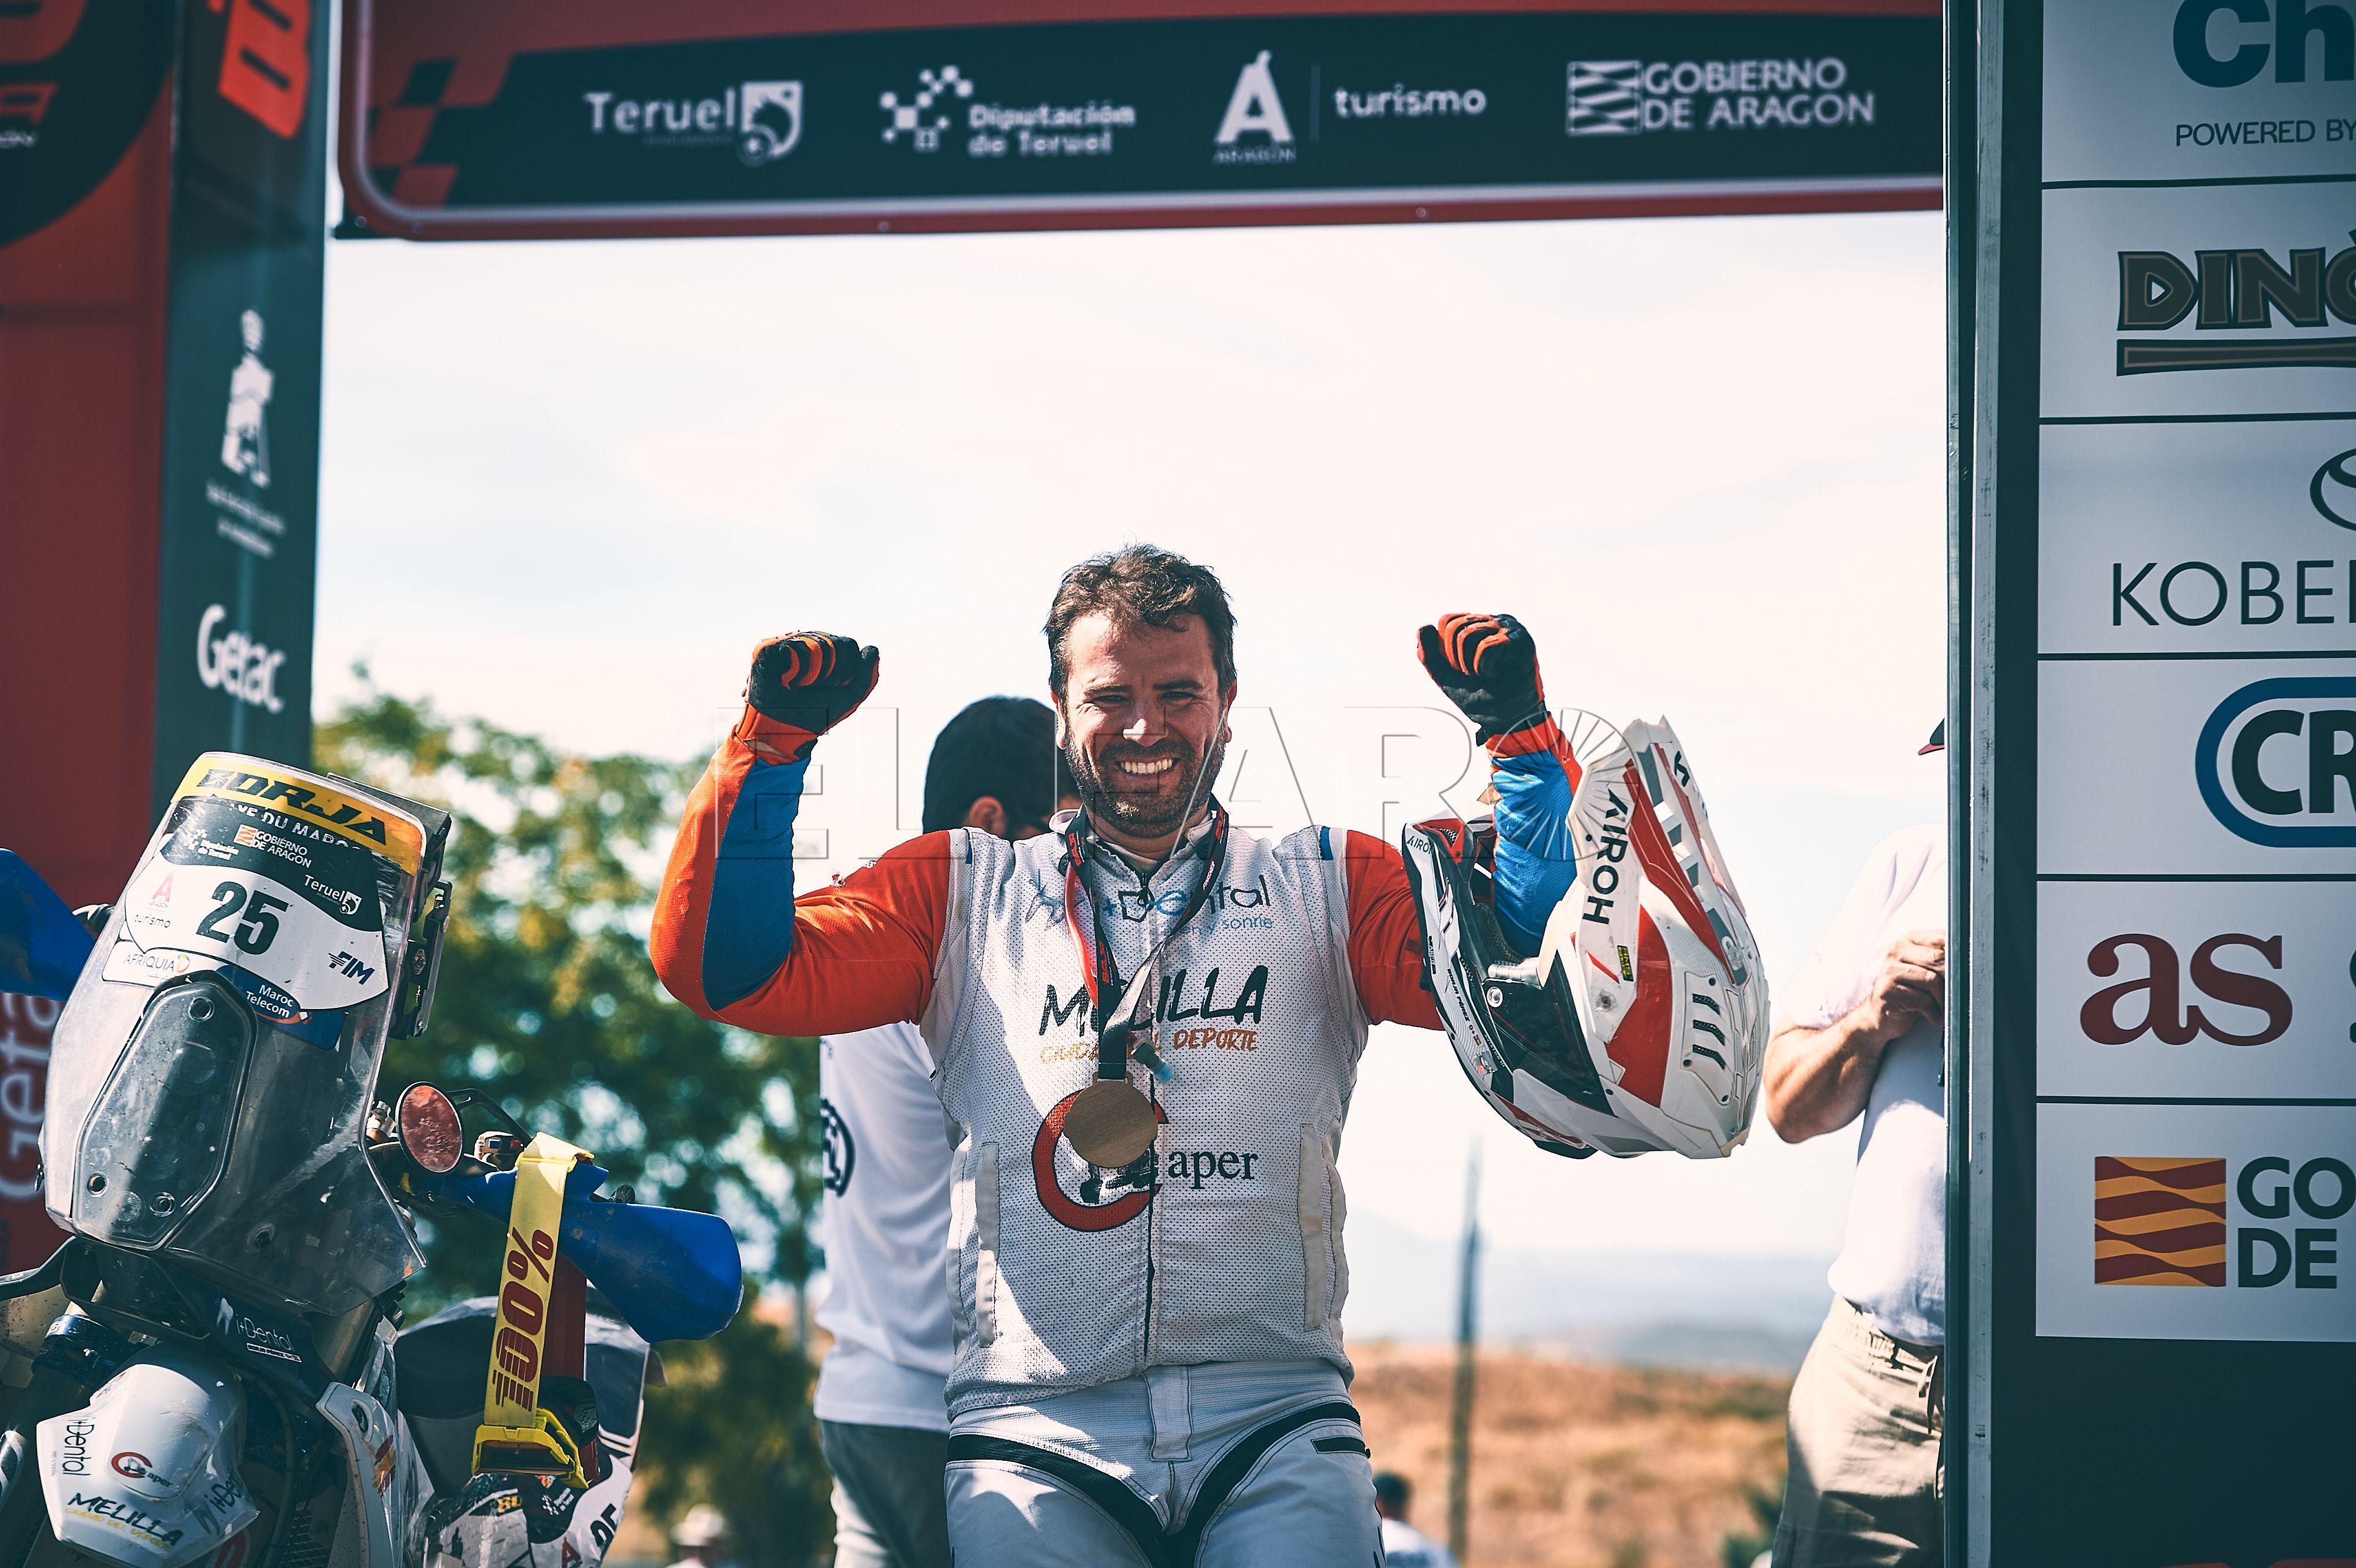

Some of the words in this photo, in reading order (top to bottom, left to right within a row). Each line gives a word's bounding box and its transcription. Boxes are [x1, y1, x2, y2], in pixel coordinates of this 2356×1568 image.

[1644, 58, 1847, 94] GOBIERNO
[583, 87, 736, 133] Teruel
[1334, 83, 1487, 117] turismo
[1644, 98, 1693, 130] DE
[2176, 121, 2316, 147] POWERED
[2113, 560, 2356, 626] KOBE
[196, 769, 387, 846] BORJA
[252, 840, 267, 851] DE
[255, 831, 307, 855] GOBIERNO
[1582, 788, 1629, 925] AIROH
[304, 874, 345, 902] Teruel
[134, 912, 171, 928] turismo
[196, 881, 289, 956] 25
[123, 953, 174, 972] AFRIQUIA
[328, 951, 375, 985] FIM
[246, 991, 290, 1018] Telecom
[259, 984, 294, 1007] Maroc
[1038, 964, 1269, 1037] MILLA
[2080, 933, 2293, 1046] as
[1173, 1027, 1259, 1052] DEPORTE
[2236, 1156, 2356, 1220] GO
[2238, 1228, 2338, 1289] DE
[491, 1226, 554, 1413] 100%
[67, 1492, 184, 1547] MELILLA
